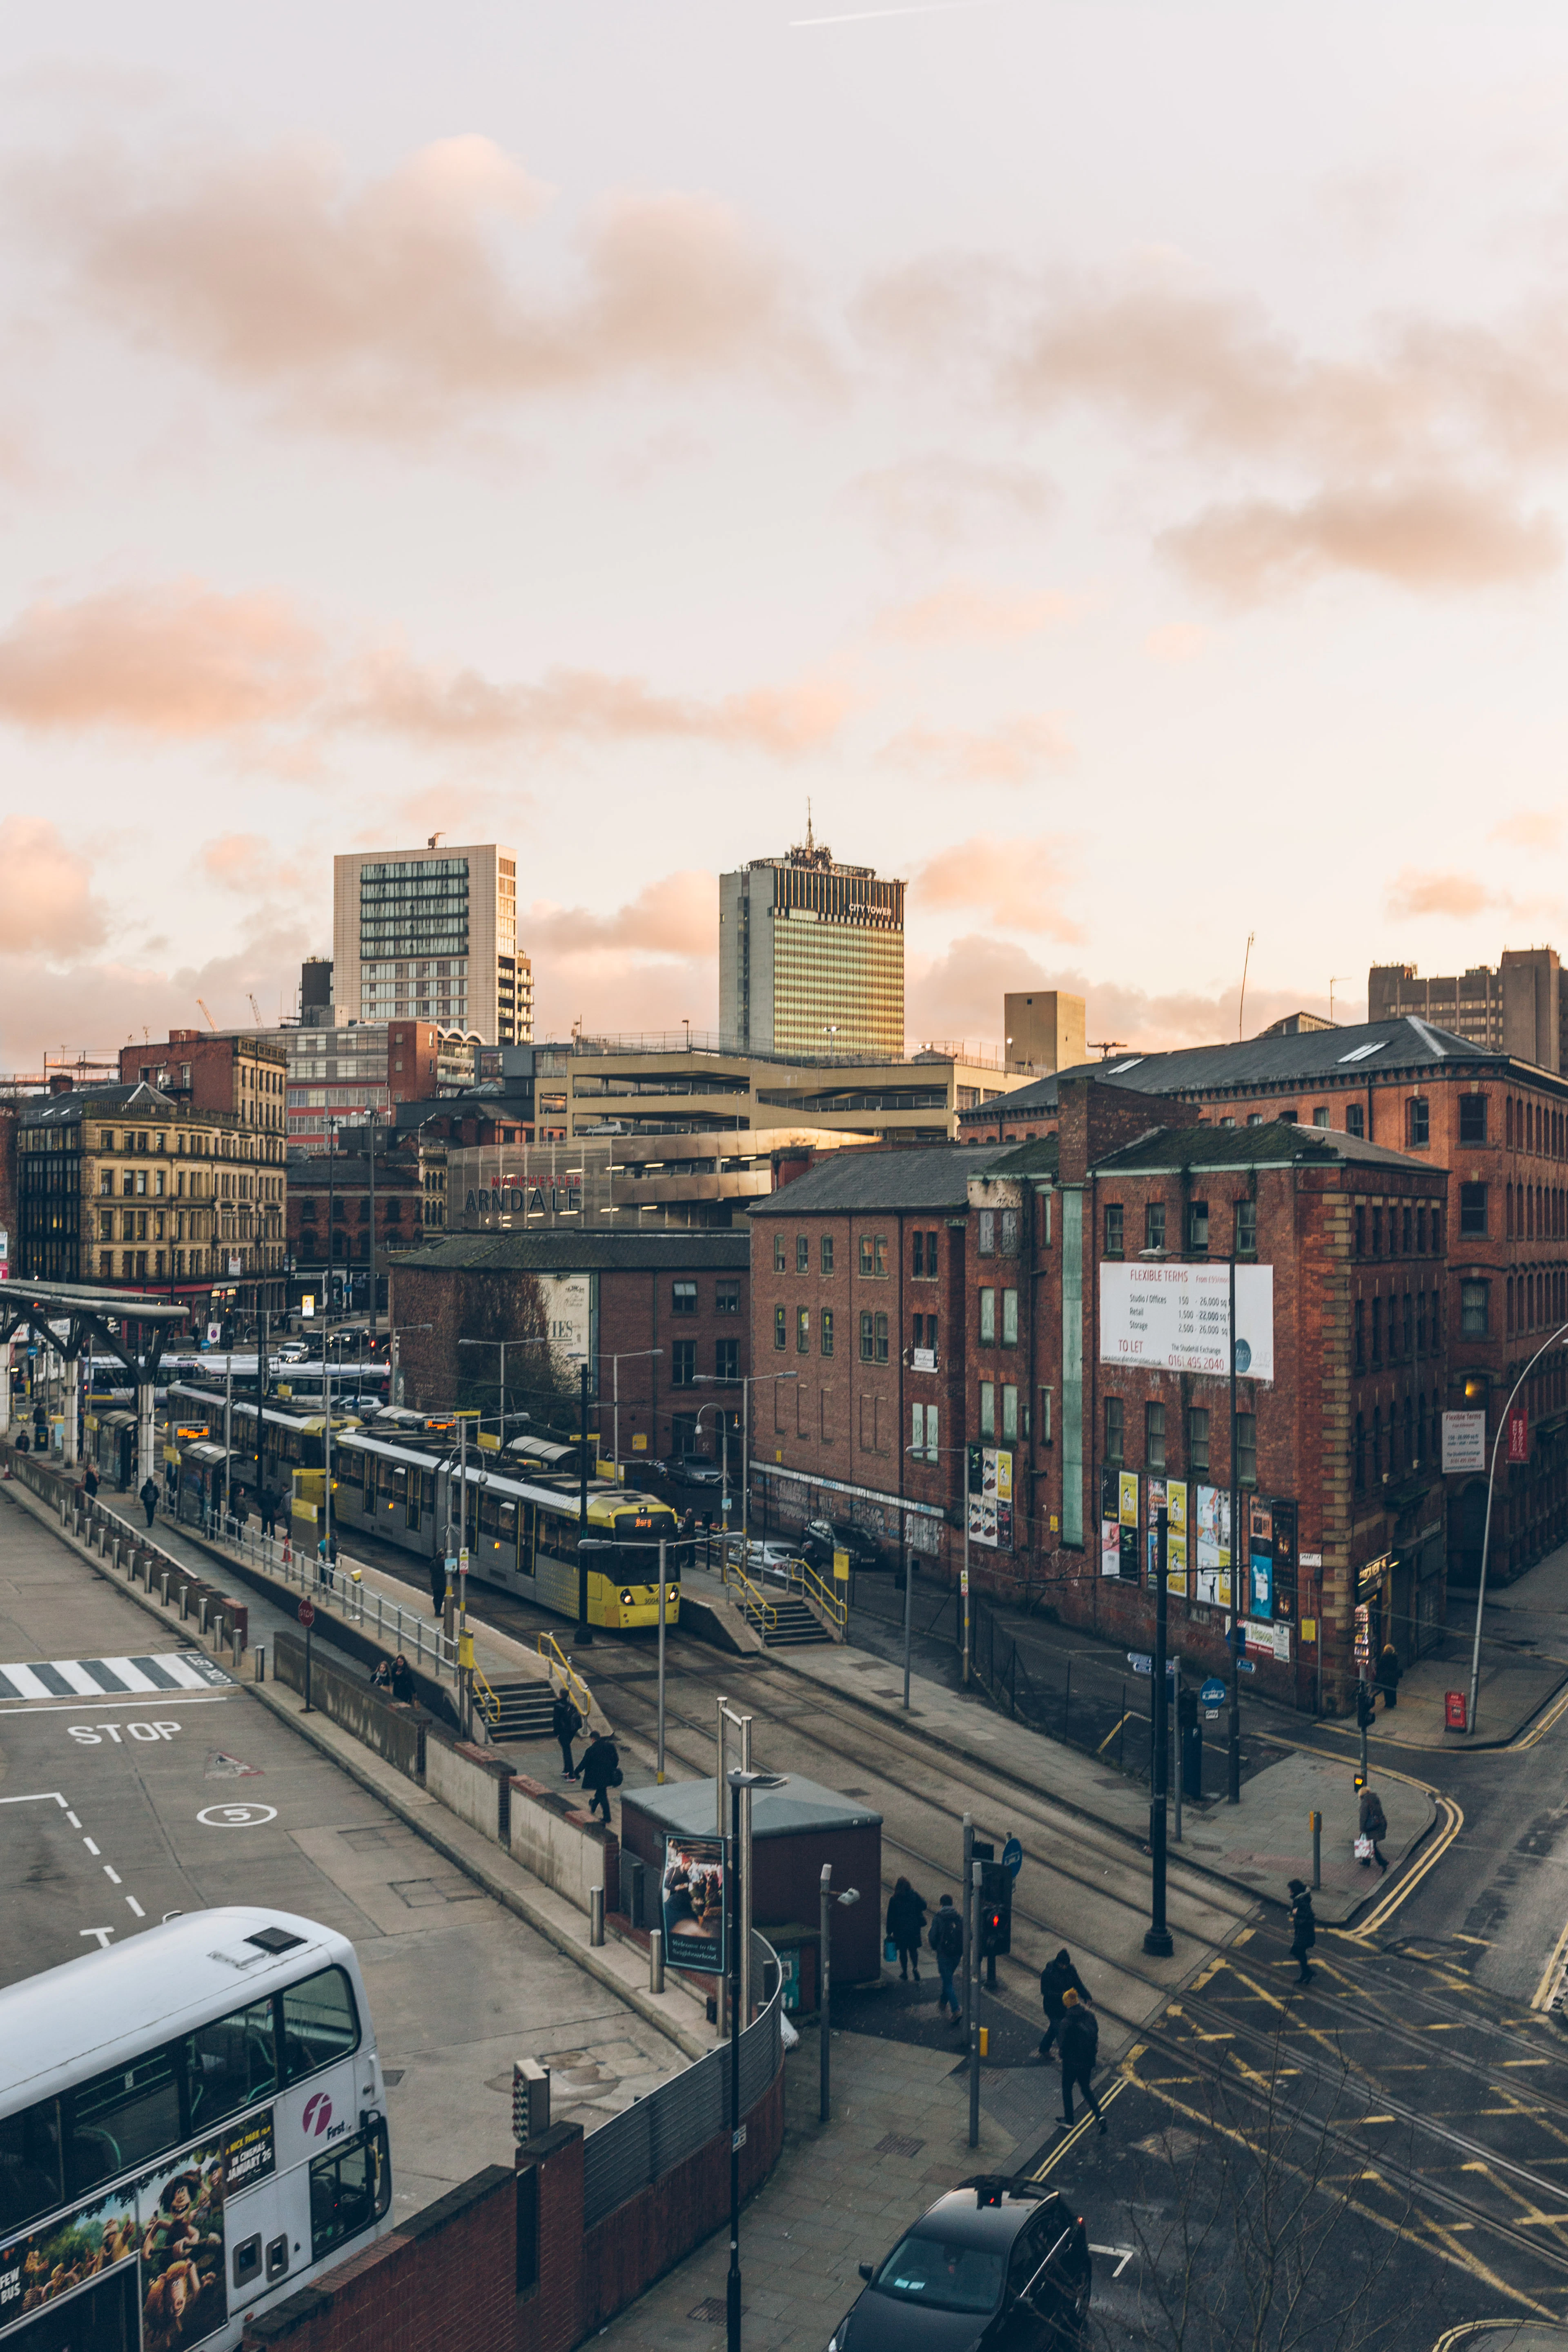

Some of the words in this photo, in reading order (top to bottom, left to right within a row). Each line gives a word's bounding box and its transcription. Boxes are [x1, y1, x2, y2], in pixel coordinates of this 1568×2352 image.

[849, 903, 865, 913] CITY
[866, 905, 891, 916] TOWER
[491, 1175, 581, 1187] MANCHESTER
[466, 1187, 582, 1212] ARNDALE
[1131, 1269, 1162, 1281] FLEXIBLE
[1164, 1270, 1188, 1282] TERMS
[1130, 1294, 1145, 1303] Studio
[1149, 1294, 1167, 1304] Offices
[1178, 1296, 1189, 1305] 150
[1200, 1297, 1219, 1306] 26,000
[1221, 1299, 1227, 1308] sq
[1129, 1307, 1143, 1316] Retail
[1178, 1310, 1194, 1319] 1,500
[1199, 1311, 1218, 1321] 22,000
[1220, 1314, 1226, 1322] sq
[1129, 1320, 1148, 1332] Storage
[1178, 1323, 1194, 1333] 2,500
[1199, 1325, 1219, 1334] 26,000
[1222, 1328, 1227, 1336] sq
[1118, 1339, 1128, 1352] TO
[1130, 1340, 1143, 1353] LET
[1200, 1345, 1221, 1356] Exchange
[1169, 1354, 1184, 1368] 0161
[1187, 1356, 1201, 1368] 495
[1204, 1358, 1224, 1370] 2040
[67, 1722, 182, 1744] STOP
[223, 1808, 251, 1821] 5
[672, 1939, 698, 1949] Welcome
[327, 2120, 345, 2140] First
[230, 2138, 244, 2153] NICK
[245, 2129, 260, 2144] PARK
[232, 2155, 239, 2167] IN
[240, 2141, 265, 2162] CINEMAS
[226, 2153, 261, 2182] JANUARY
[262, 2147, 272, 2163] 26
[0, 2266, 20, 2289] FEW
[1, 2282, 20, 2305] BUS
